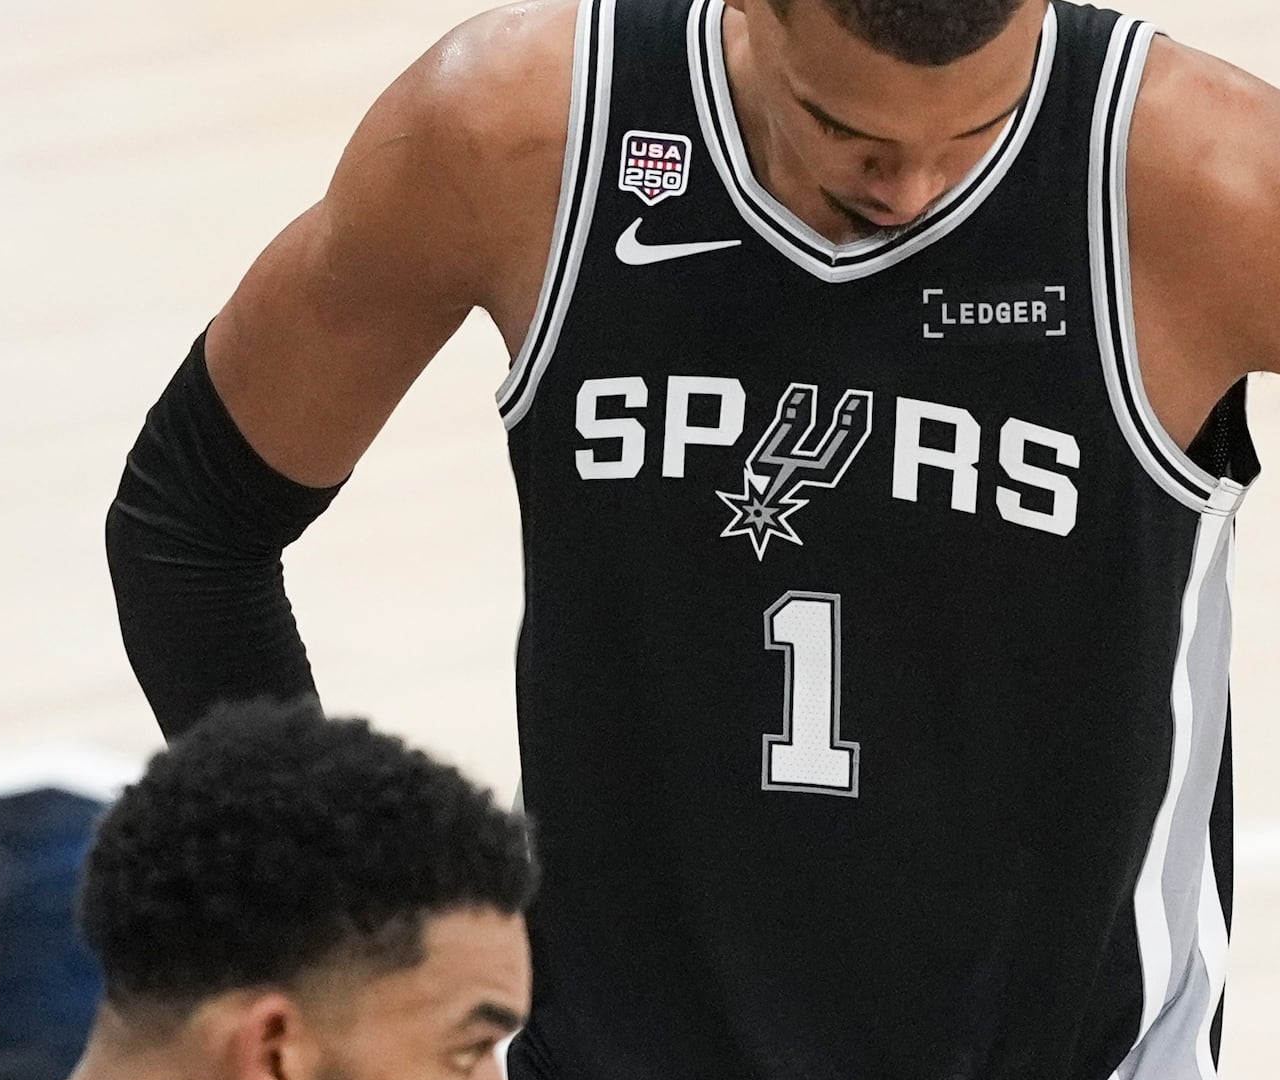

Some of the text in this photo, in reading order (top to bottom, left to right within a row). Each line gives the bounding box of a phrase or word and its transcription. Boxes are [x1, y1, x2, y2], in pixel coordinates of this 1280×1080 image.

[631, 141, 682, 160] USA
[624, 167, 682, 190] 250
[940, 300, 1048, 326] LEDGER
[575, 375, 1081, 562] SPURS
[761, 590, 861, 798] 1
